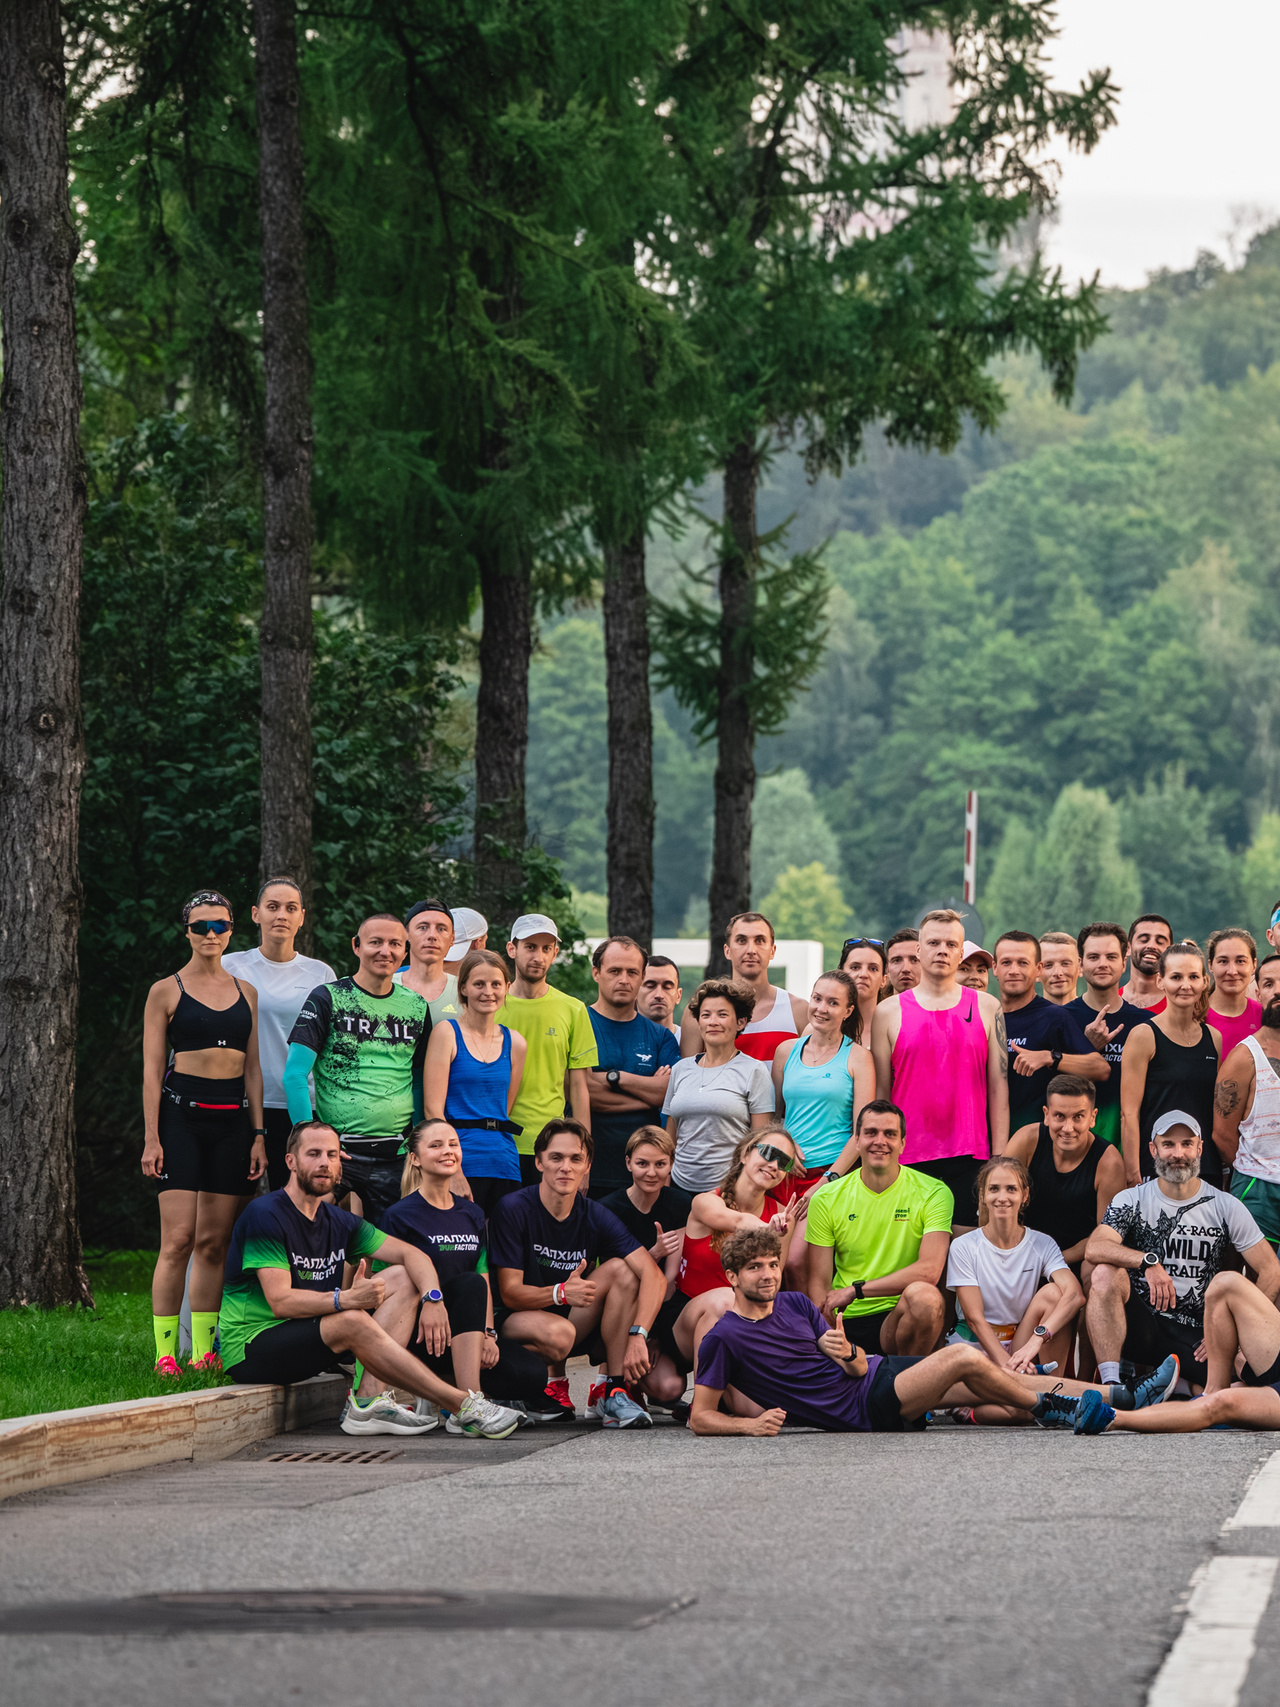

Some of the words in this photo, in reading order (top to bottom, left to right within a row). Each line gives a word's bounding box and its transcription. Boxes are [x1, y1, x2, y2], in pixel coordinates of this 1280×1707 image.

[1177, 1225, 1222, 1237] X-RACE
[428, 1234, 480, 1243] УРАЛХИМ
[1165, 1238, 1212, 1261] WILD
